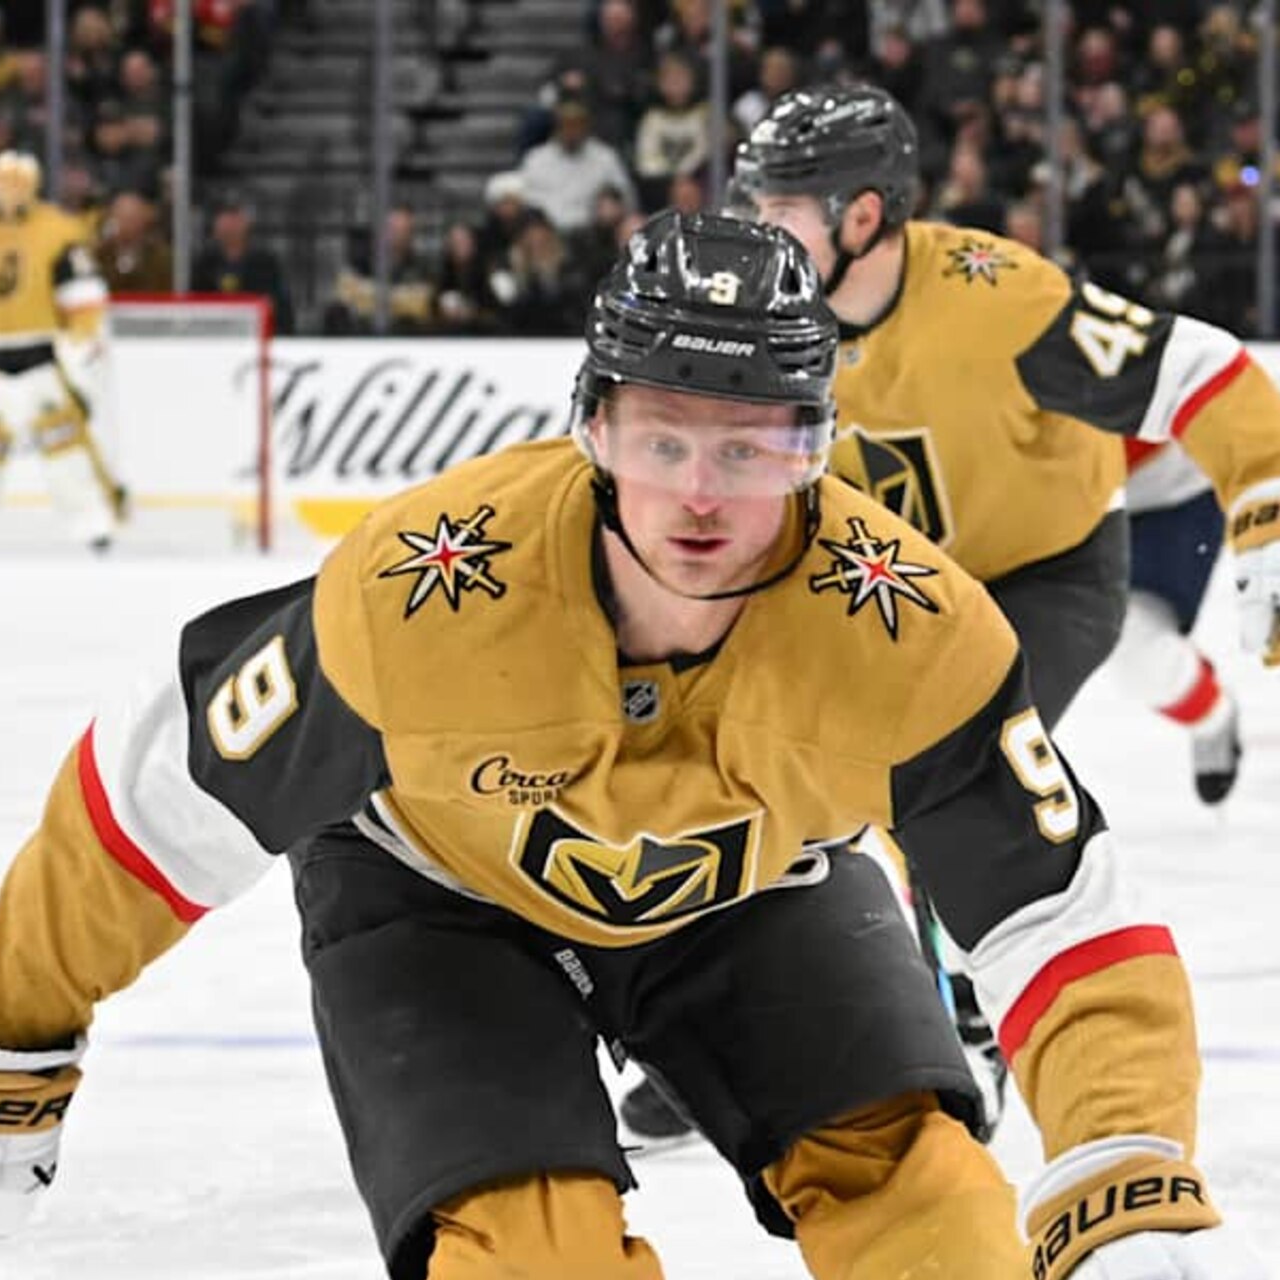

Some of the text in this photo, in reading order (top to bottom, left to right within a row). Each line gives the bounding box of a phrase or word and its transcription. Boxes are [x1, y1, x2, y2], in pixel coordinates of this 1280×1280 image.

[708, 271, 741, 305] 9
[672, 334, 756, 357] BAUER
[233, 356, 575, 480] Willia
[206, 634, 300, 760] 9
[470, 756, 569, 795] Circa
[999, 705, 1080, 845] 9
